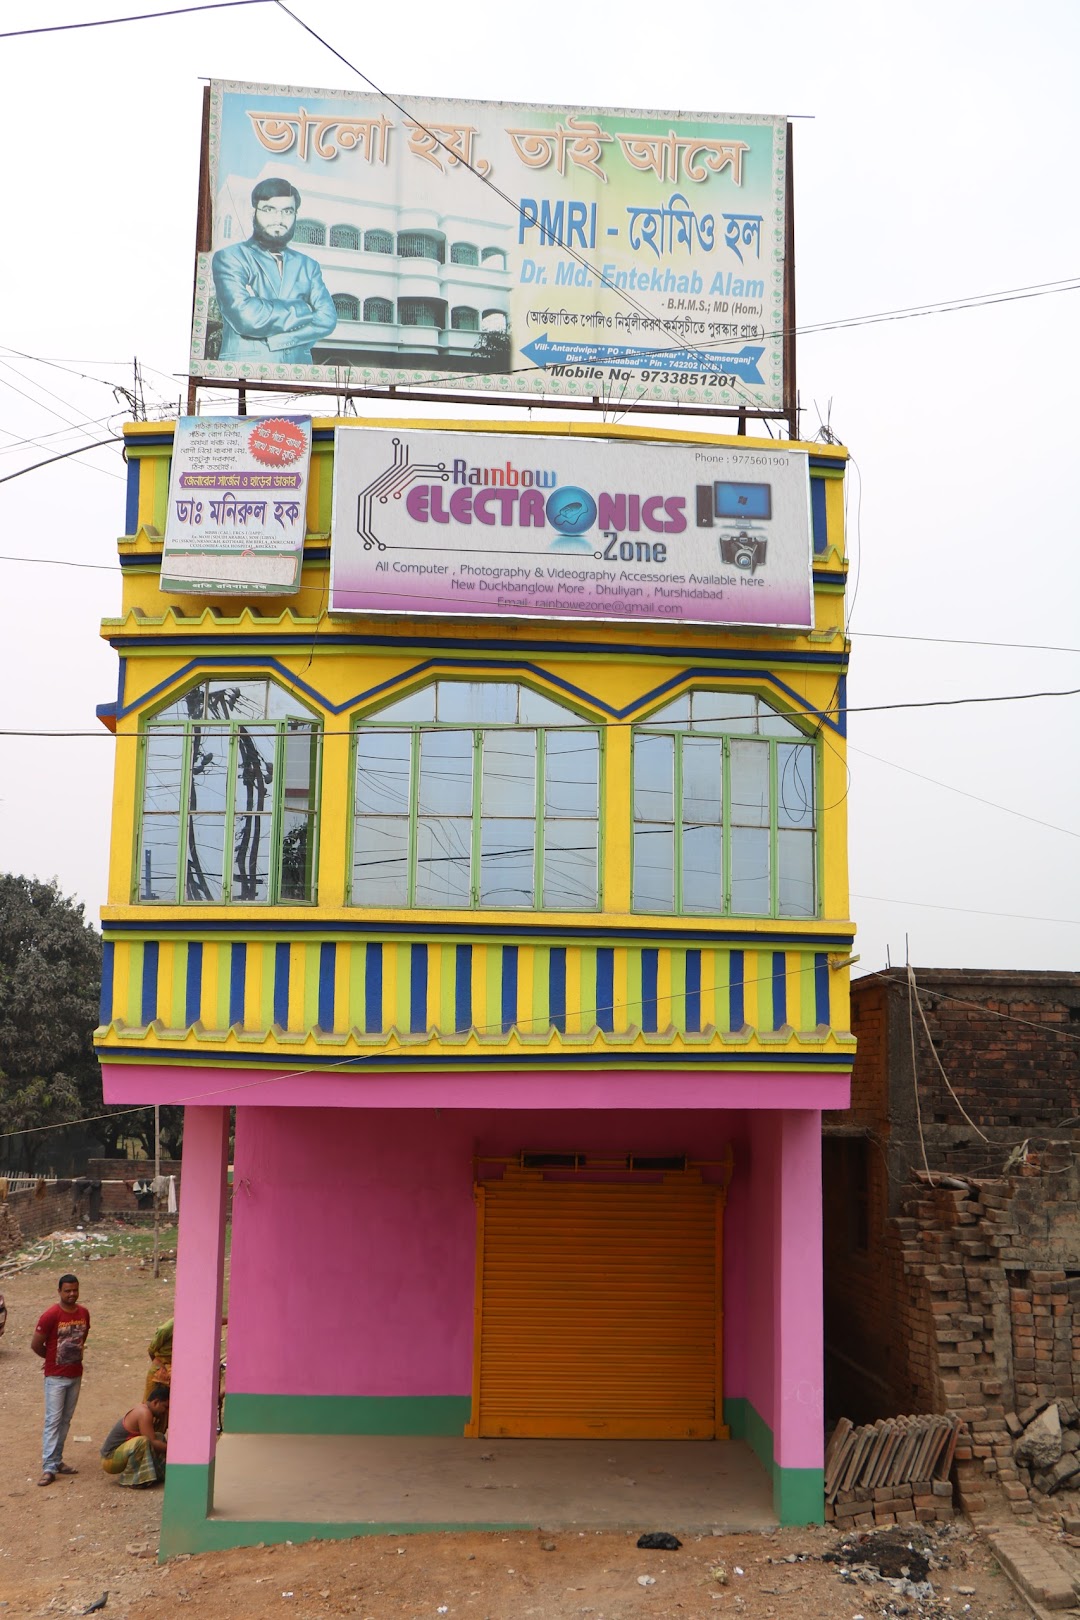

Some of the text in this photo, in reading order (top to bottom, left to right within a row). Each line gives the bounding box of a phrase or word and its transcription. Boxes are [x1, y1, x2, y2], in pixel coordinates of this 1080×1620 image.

[245, 107, 394, 166] ভালো
[504, 115, 614, 183] তাই
[615, 131, 750, 187] আসে
[519, 198, 596, 248] PMRI
[626, 193, 714, 261] হোমিও
[722, 213, 764, 265] হল
[520, 259, 765, 298] Dr. Md. Entekhab Alam
[713, 301, 729, 313] MD
[731, 302, 763, 318] (Hom.)
[581, 311, 612, 328] পোলিও
[708, 322, 738, 338] পুরস্কার
[566, 354, 582, 362] Dist
[649, 359, 663, 367] Pin
[669, 361, 698, 370] 742202
[687, 352, 698, 360] PS
[550, 365, 604, 378] Mobile
[641, 370, 737, 388] 9733851201
[695, 453, 724, 464] Phone
[732, 455, 790, 466] 9775601901
[184, 475, 216, 486] জেনারেল
[242, 477, 249, 486] ও
[273, 476, 297, 487] ডাক্তার
[453, 459, 557, 488] Rainbow
[176, 492, 301, 529] ডাঃ মনিরুল হক
[603, 532, 667, 562] Zone
[375, 562, 389, 572] All
[393, 562, 449, 575] Computer
[460, 565, 531, 579] Photography
[534, 567, 544, 577] &
[547, 567, 616, 582] Videography
[619, 571, 686, 584] Accessories
[689, 573, 737, 586] Available
[740, 575, 765, 587] here
[451, 579, 475, 590] New
[479, 580, 554, 595] Duckbanglow
[558, 583, 584, 594] More
[596, 585, 643, 597] Dhuliyan
[654, 587, 723, 600] Murshidabad
